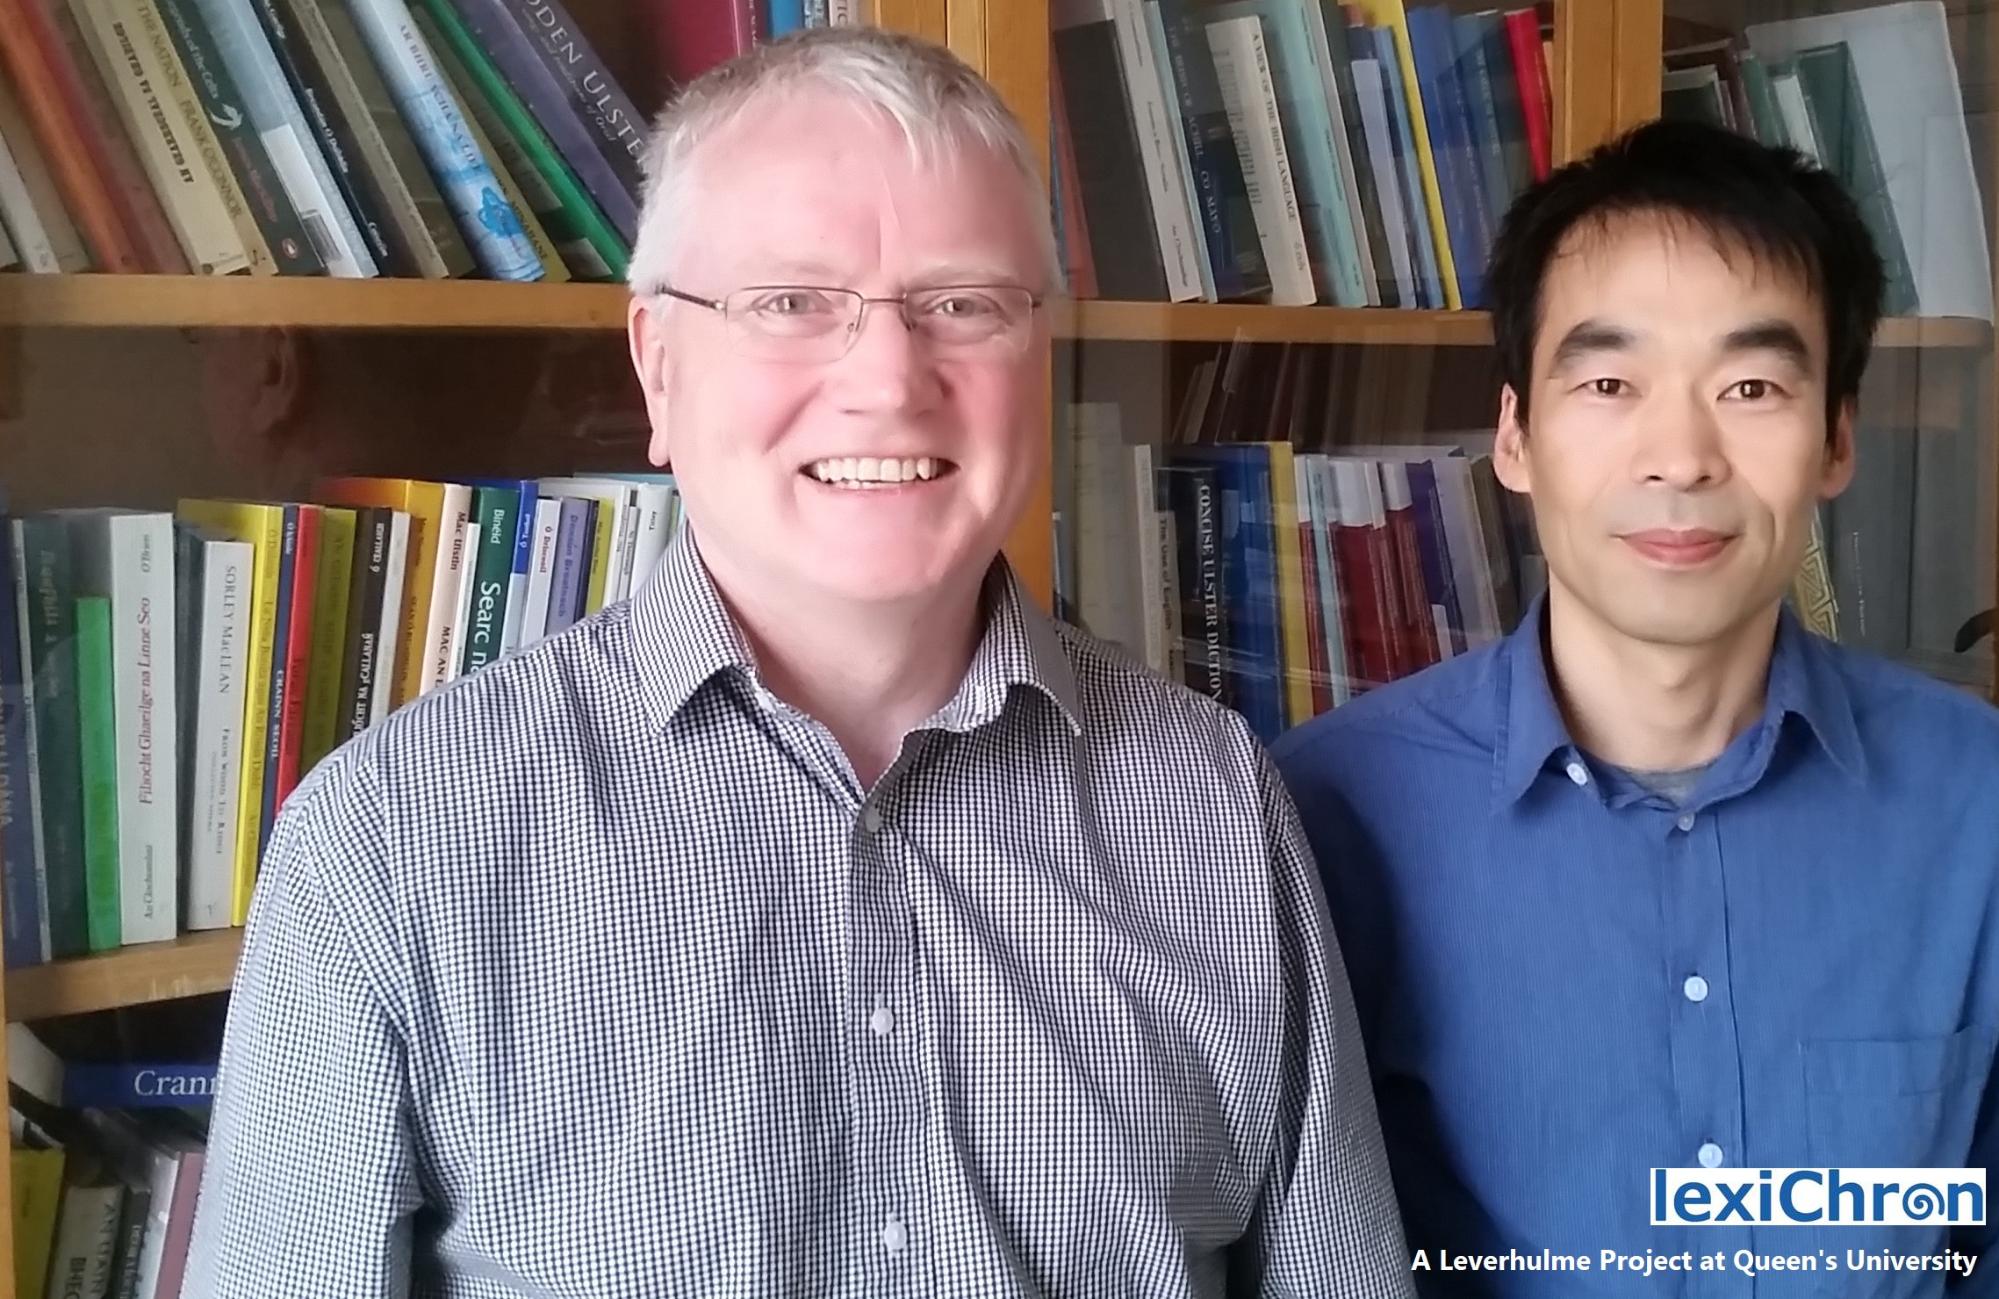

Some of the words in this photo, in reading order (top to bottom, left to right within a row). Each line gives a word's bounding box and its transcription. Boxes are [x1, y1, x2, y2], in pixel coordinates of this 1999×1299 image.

[181, 99, 208, 146] FRANK
[1264, 100, 1276, 121] THE
[1276, 159, 1297, 220] LANGUAGE
[455, 511, 467, 534] Mac
[544, 525, 554, 534] Ó
[1158, 518, 1167, 540] The
[1199, 485, 1213, 556] CONCISE
[223, 565, 236, 620] SORLEY
[1203, 557, 1219, 627] ULSTER
[138, 596, 151, 624] Seo
[474, 581, 502, 645] Searc
[138, 627, 151, 668] Linne
[440, 625, 452, 655] MAC
[142, 670, 151, 686] na
[436, 657, 447, 676] AN
